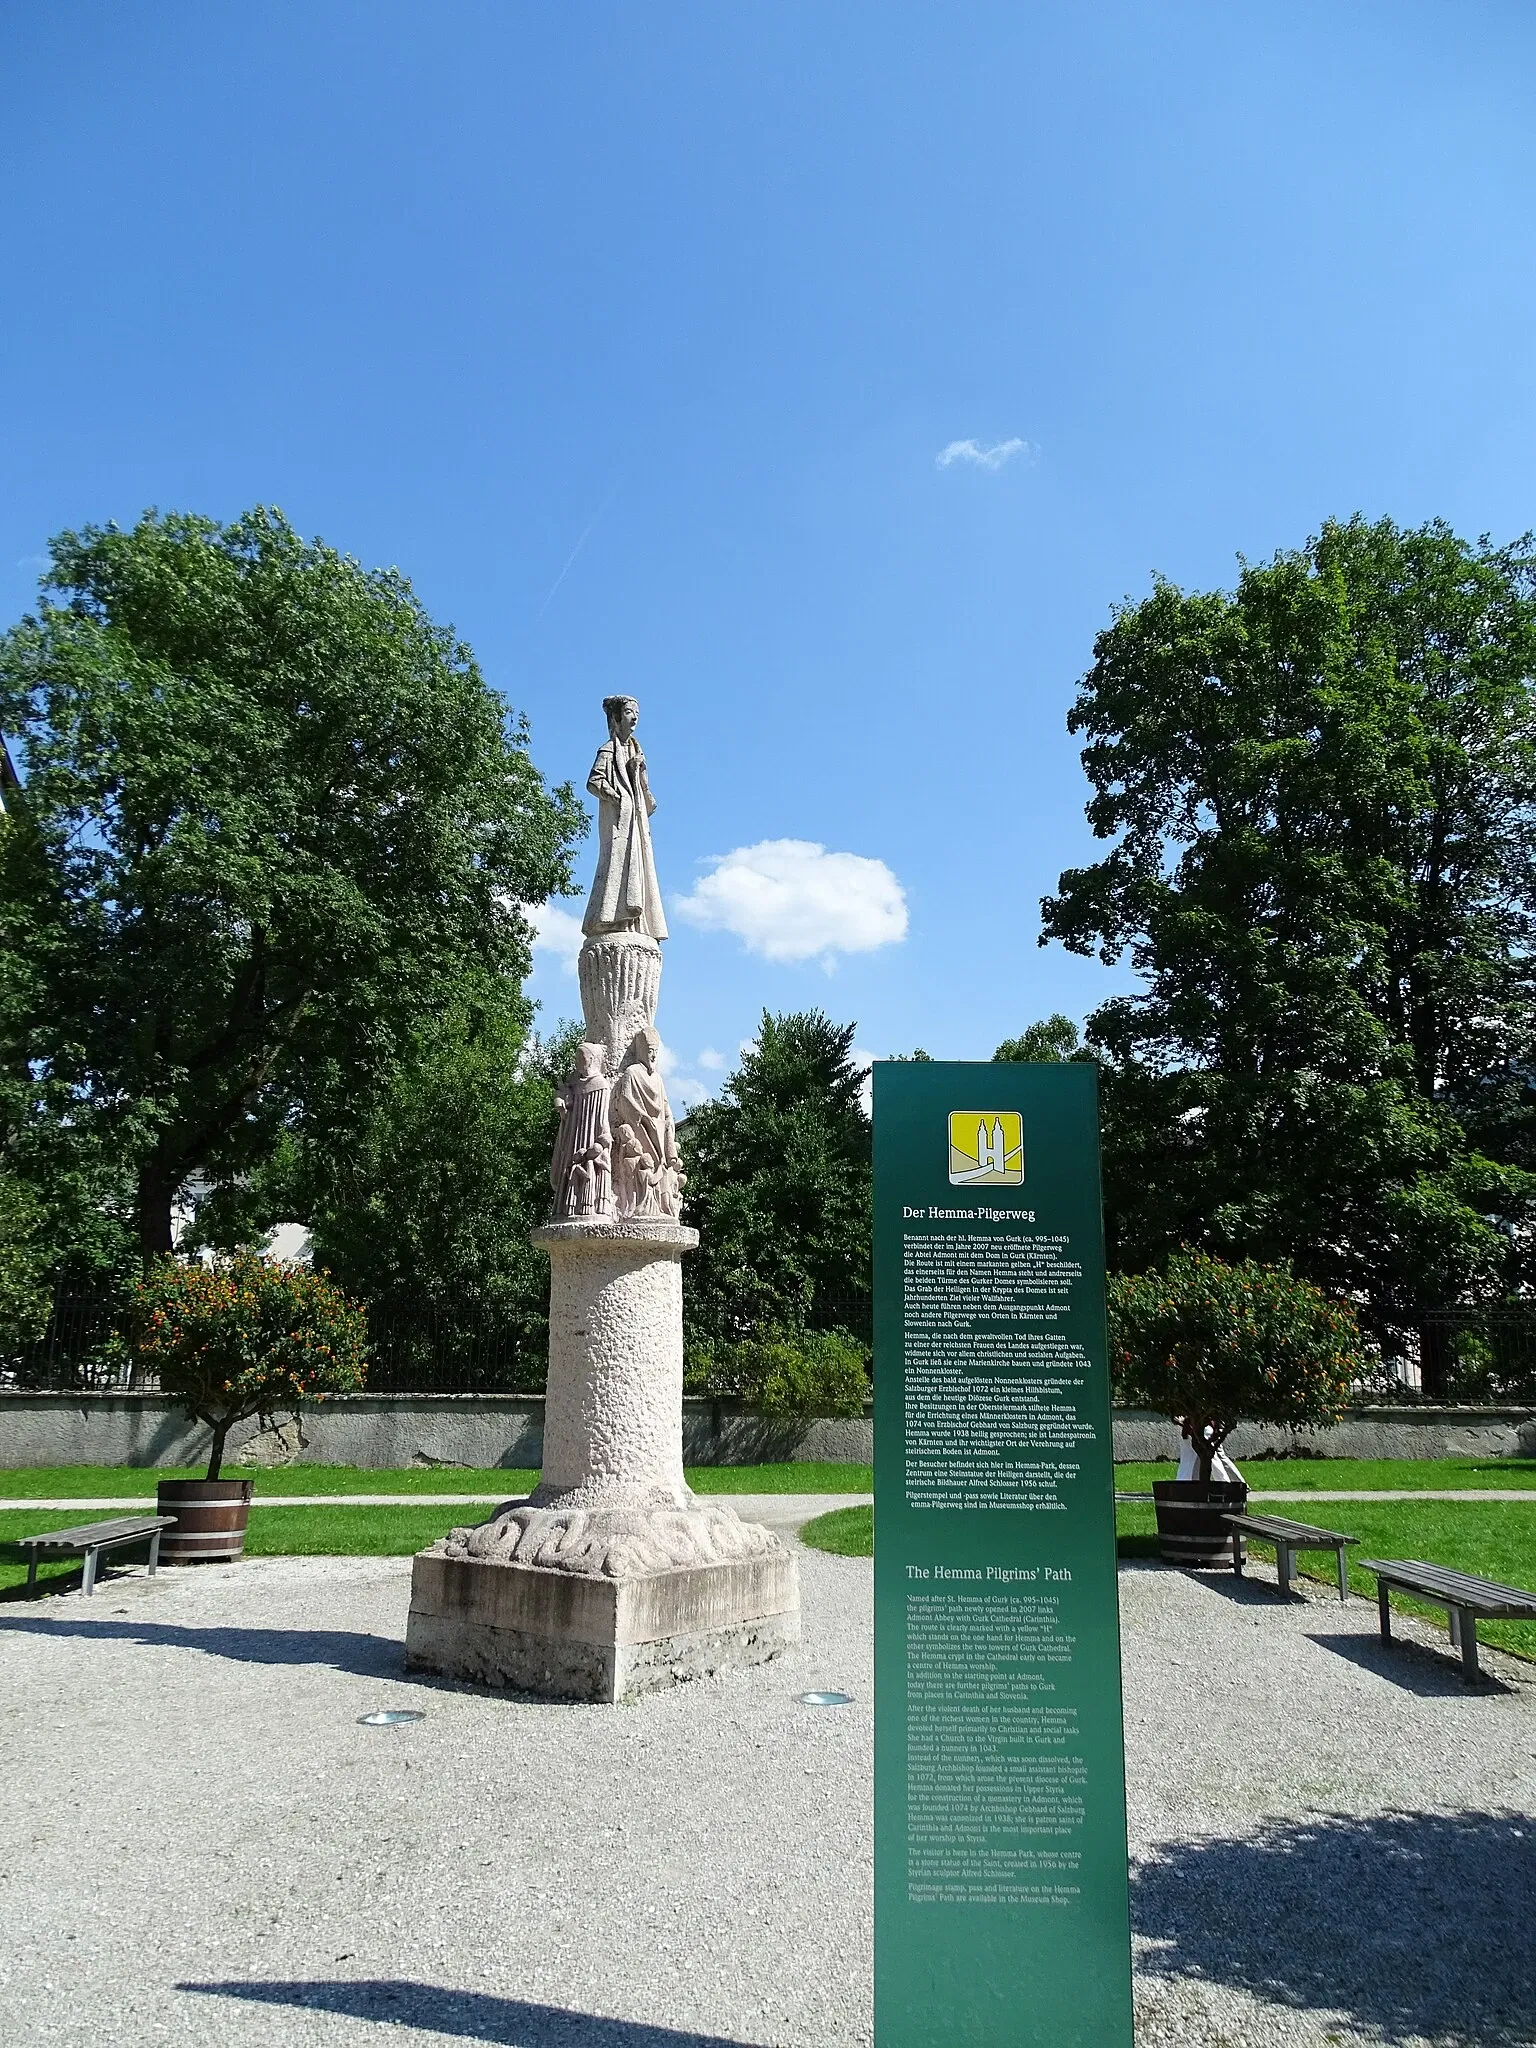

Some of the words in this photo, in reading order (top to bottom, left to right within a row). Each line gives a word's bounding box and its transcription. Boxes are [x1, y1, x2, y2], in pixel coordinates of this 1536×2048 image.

[903, 1206, 925, 1219] Der
[929, 1206, 1035, 1222] Hemma-Pilgerweg
[1032, 1244, 1062, 1252] Pilgerweg
[1026, 1252, 1057, 1261] (Kärnten).
[1011, 1260, 1031, 1269] gelben
[1046, 1261, 1081, 1269] beschildert,
[1017, 1278, 1058, 1287] symbolisieren
[946, 1285, 971, 1294] Heiligen
[992, 1286, 1012, 1295] Krypta
[998, 1303, 1044, 1312] Ausgangspunkt
[944, 1311, 976, 1320] Pilgerwege
[1015, 1461, 1057, 1470] Hemma-Park,
[998, 1470, 1024, 1479] Heiligen
[1025, 1470, 1052, 1479] darstellt,
[906, 1491, 948, 1500] Pilgerstempel
[906, 1565, 929, 1579] The
[934, 1566, 982, 1580] Hemma
[1045, 1567, 1071, 1581] Path
